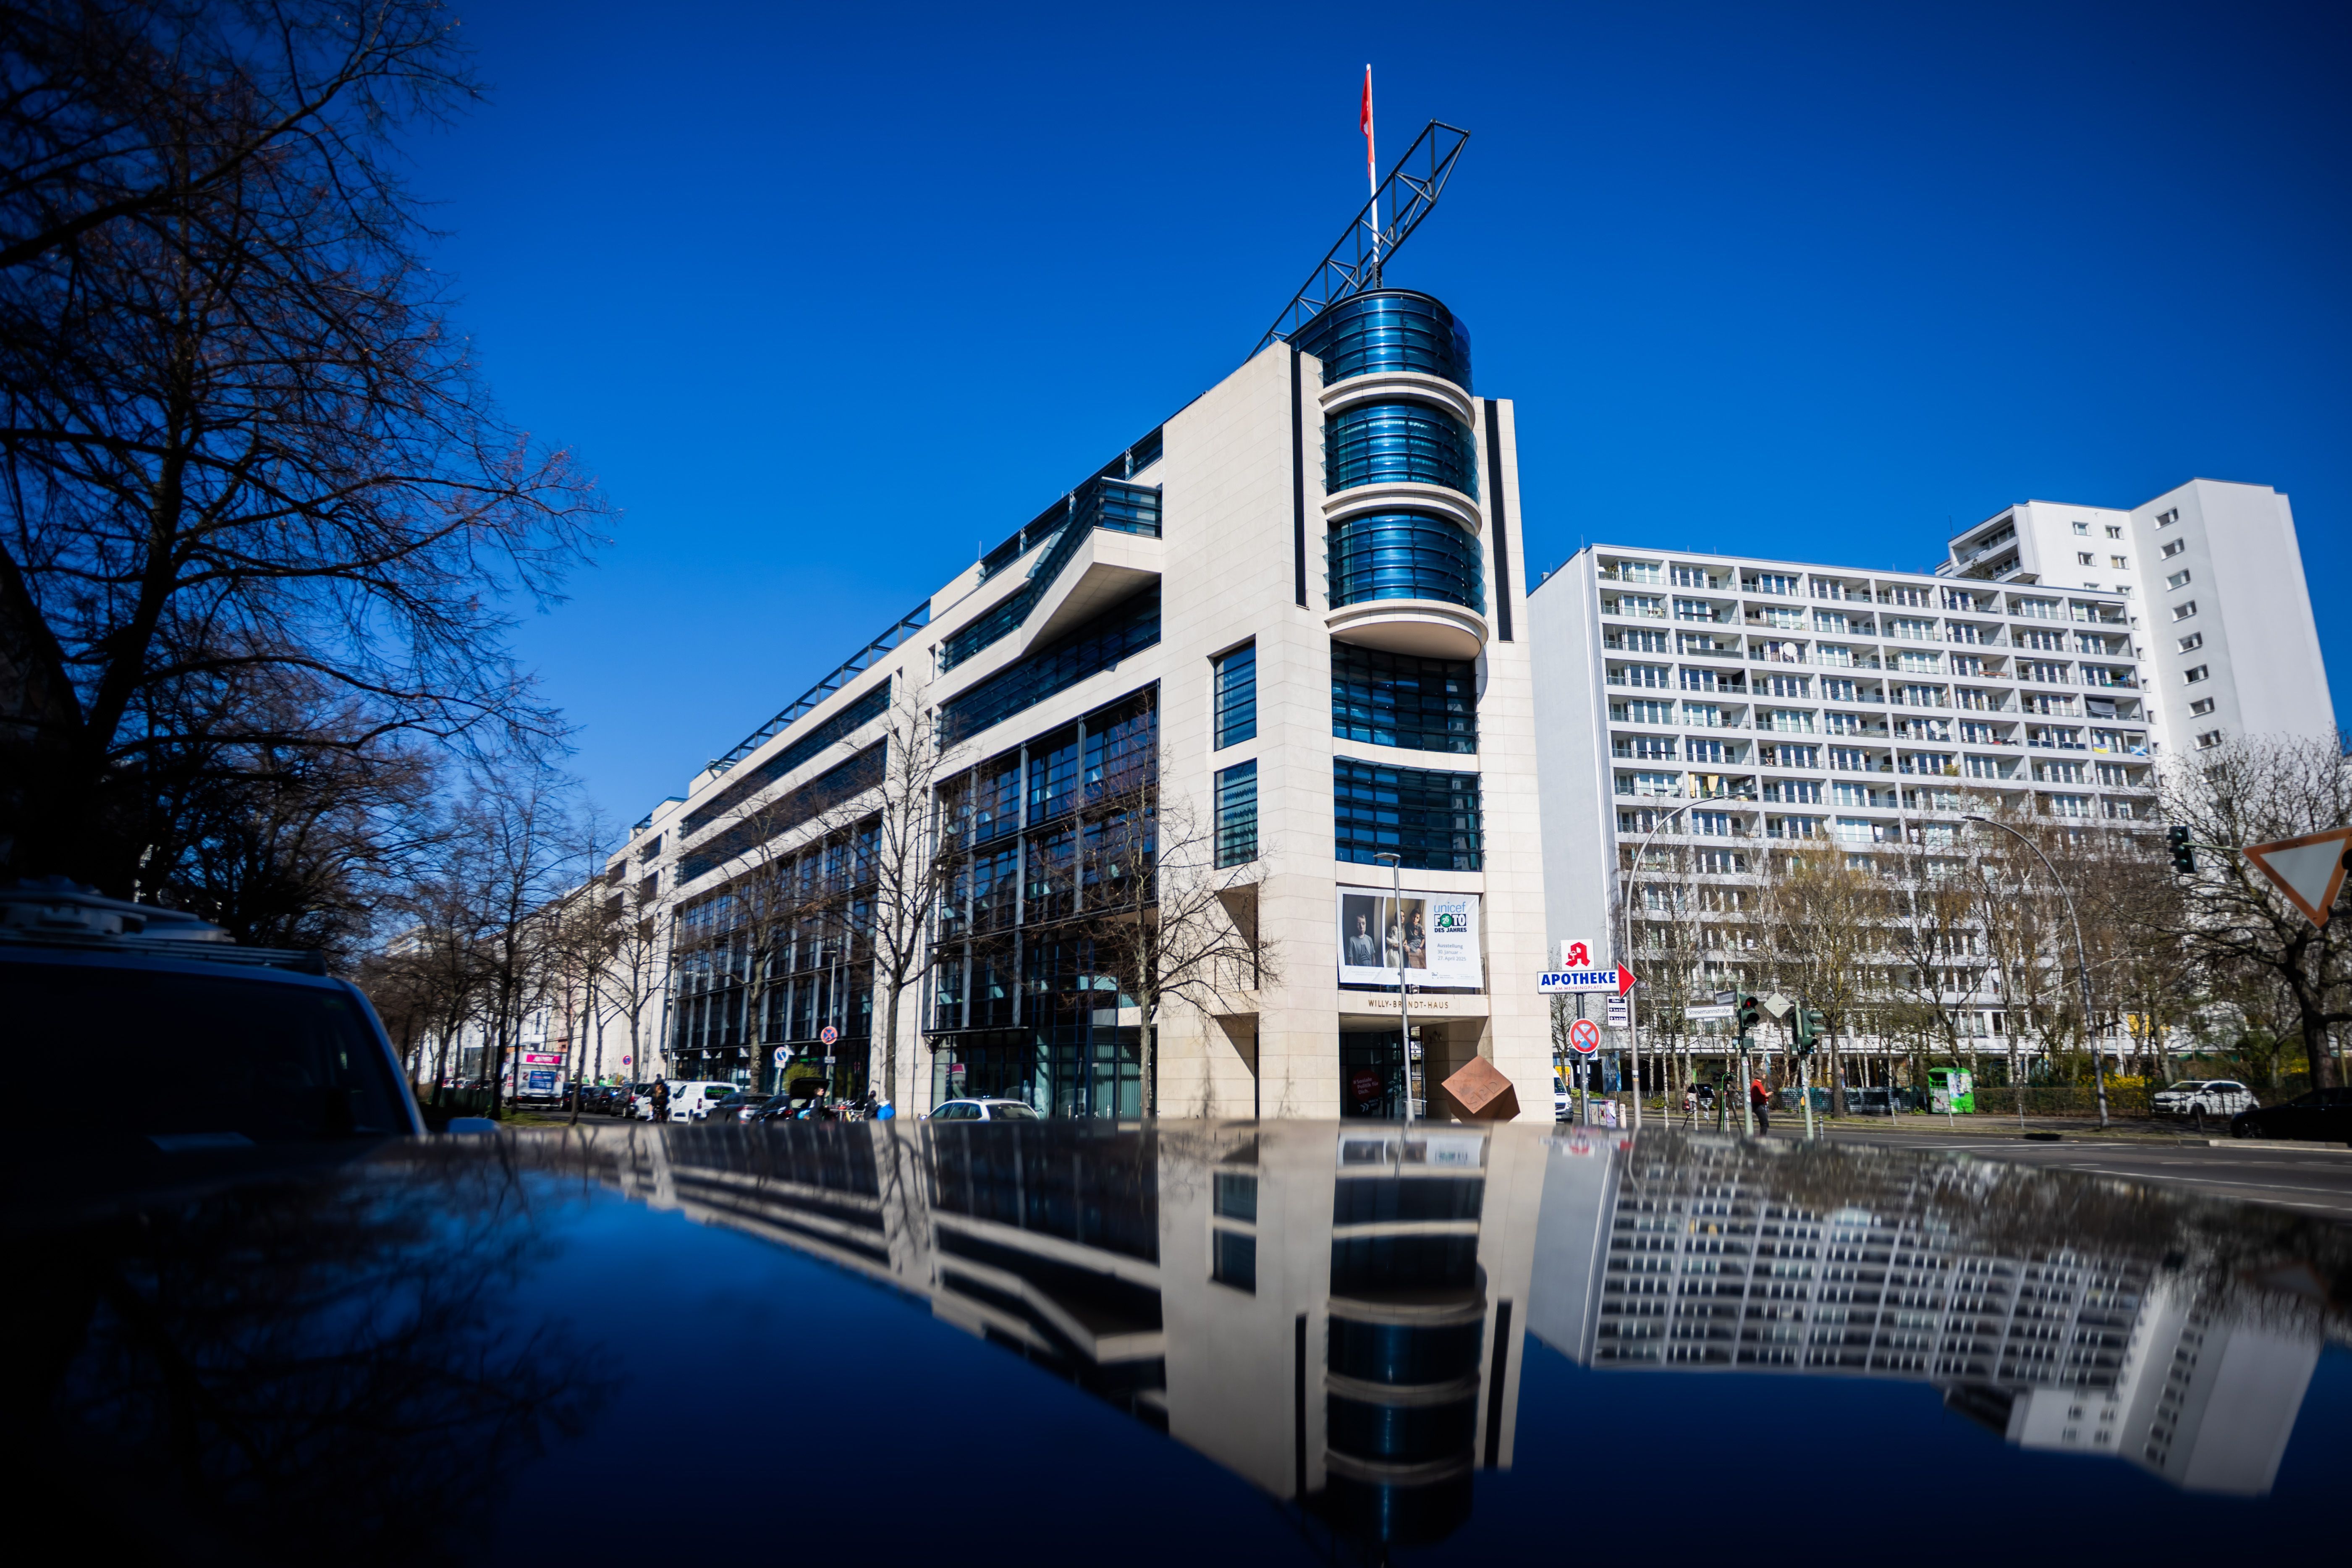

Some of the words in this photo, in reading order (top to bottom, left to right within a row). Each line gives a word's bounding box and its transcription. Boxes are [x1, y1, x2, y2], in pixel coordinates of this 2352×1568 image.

[1434, 901, 1466, 913] unicef
[1442, 916, 1450, 924] 25
[1541, 971, 1616, 986] APOTHEKE
[1368, 999, 1448, 1009] WILLY-BRNDT-HAUS
[1465, 1081, 1502, 1110] SPD
